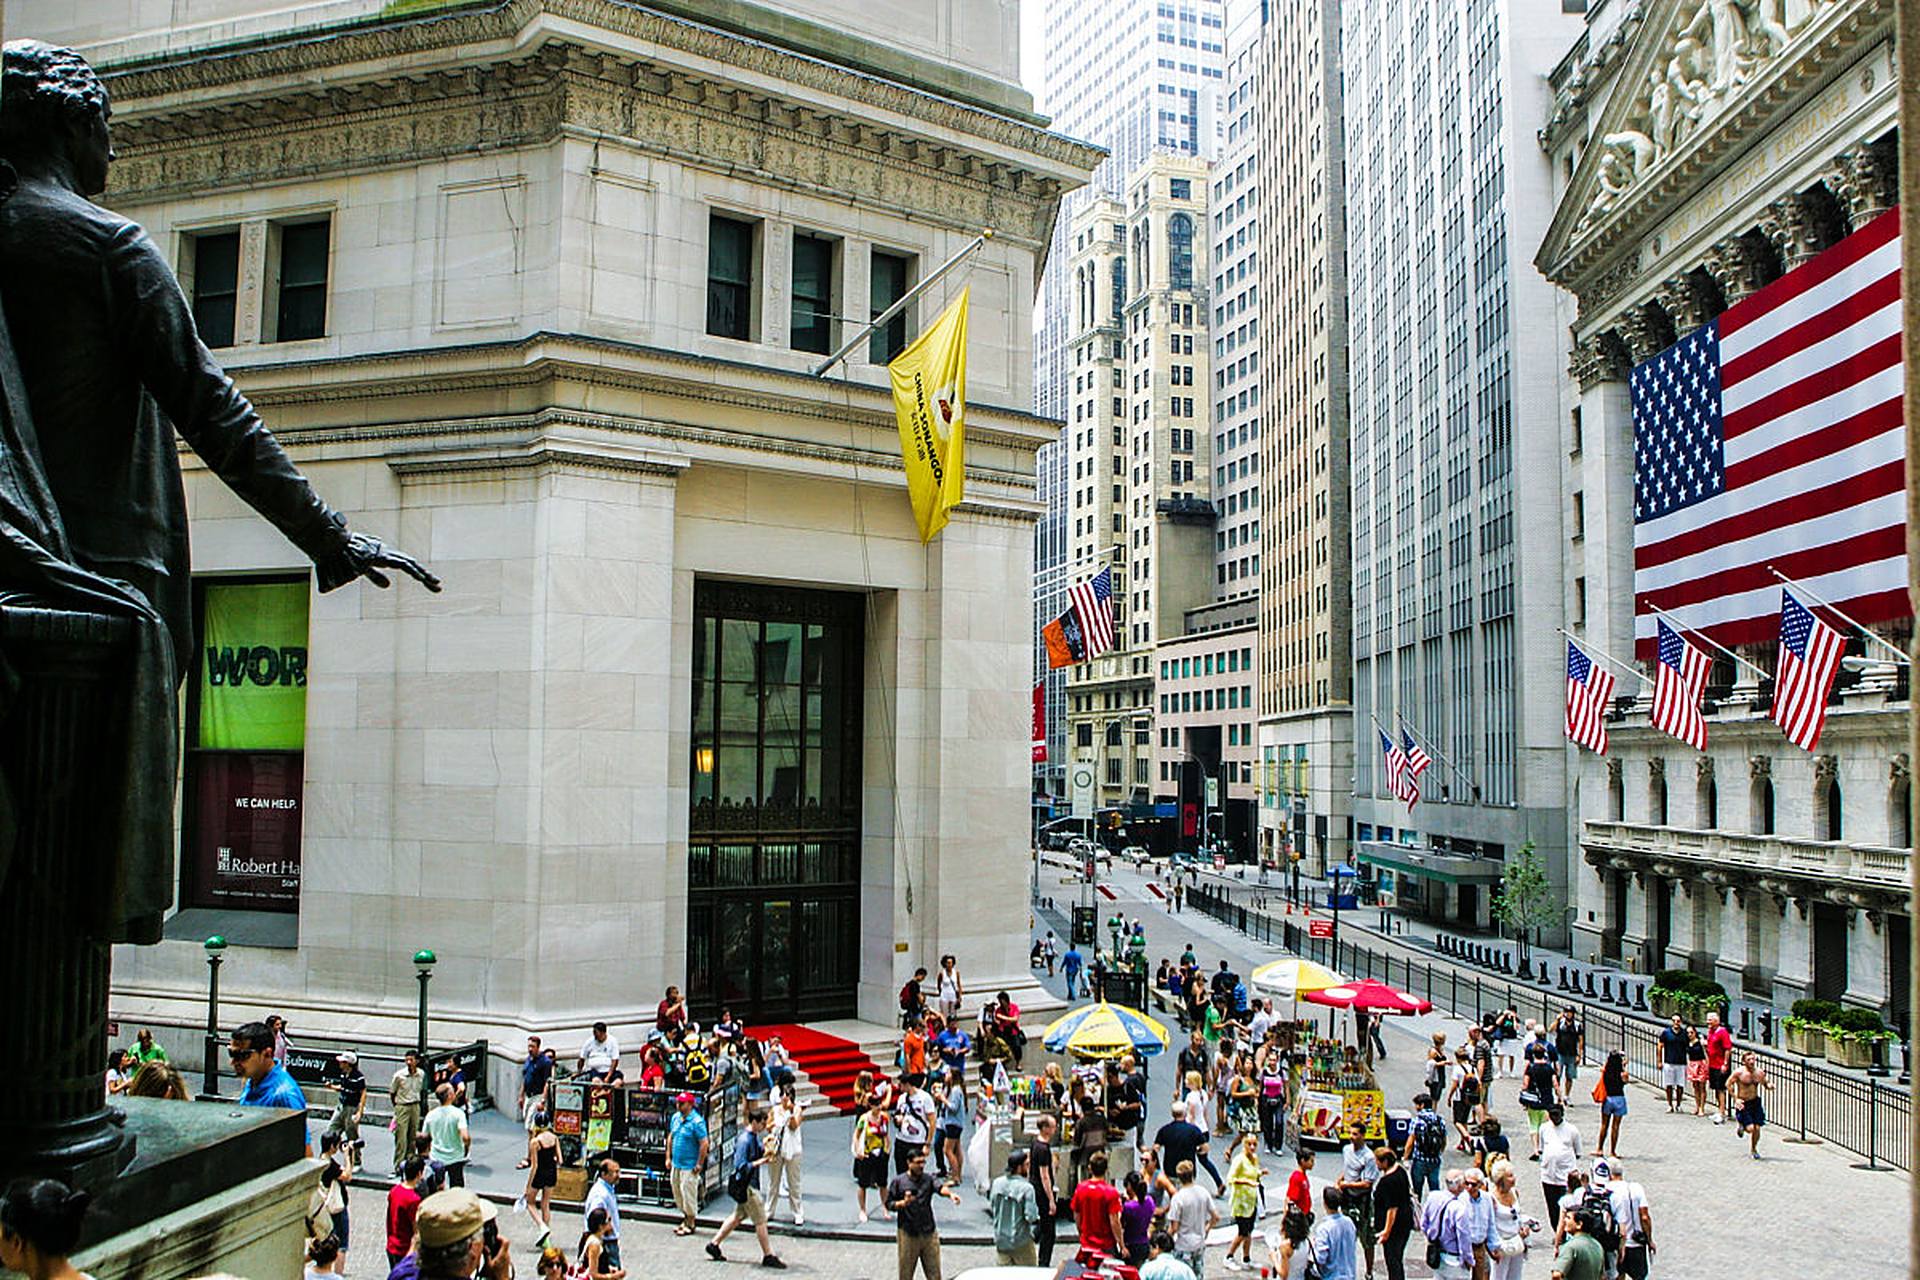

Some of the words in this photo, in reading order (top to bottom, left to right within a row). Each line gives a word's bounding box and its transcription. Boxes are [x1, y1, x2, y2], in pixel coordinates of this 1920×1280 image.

[914, 372, 925, 412] CHINA
[234, 797, 249, 808] WE
[250, 798, 270, 809] CAN
[271, 799, 297, 810] HELP.
[231, 857, 278, 874] Robert
[286, 1054, 327, 1072] Subway
